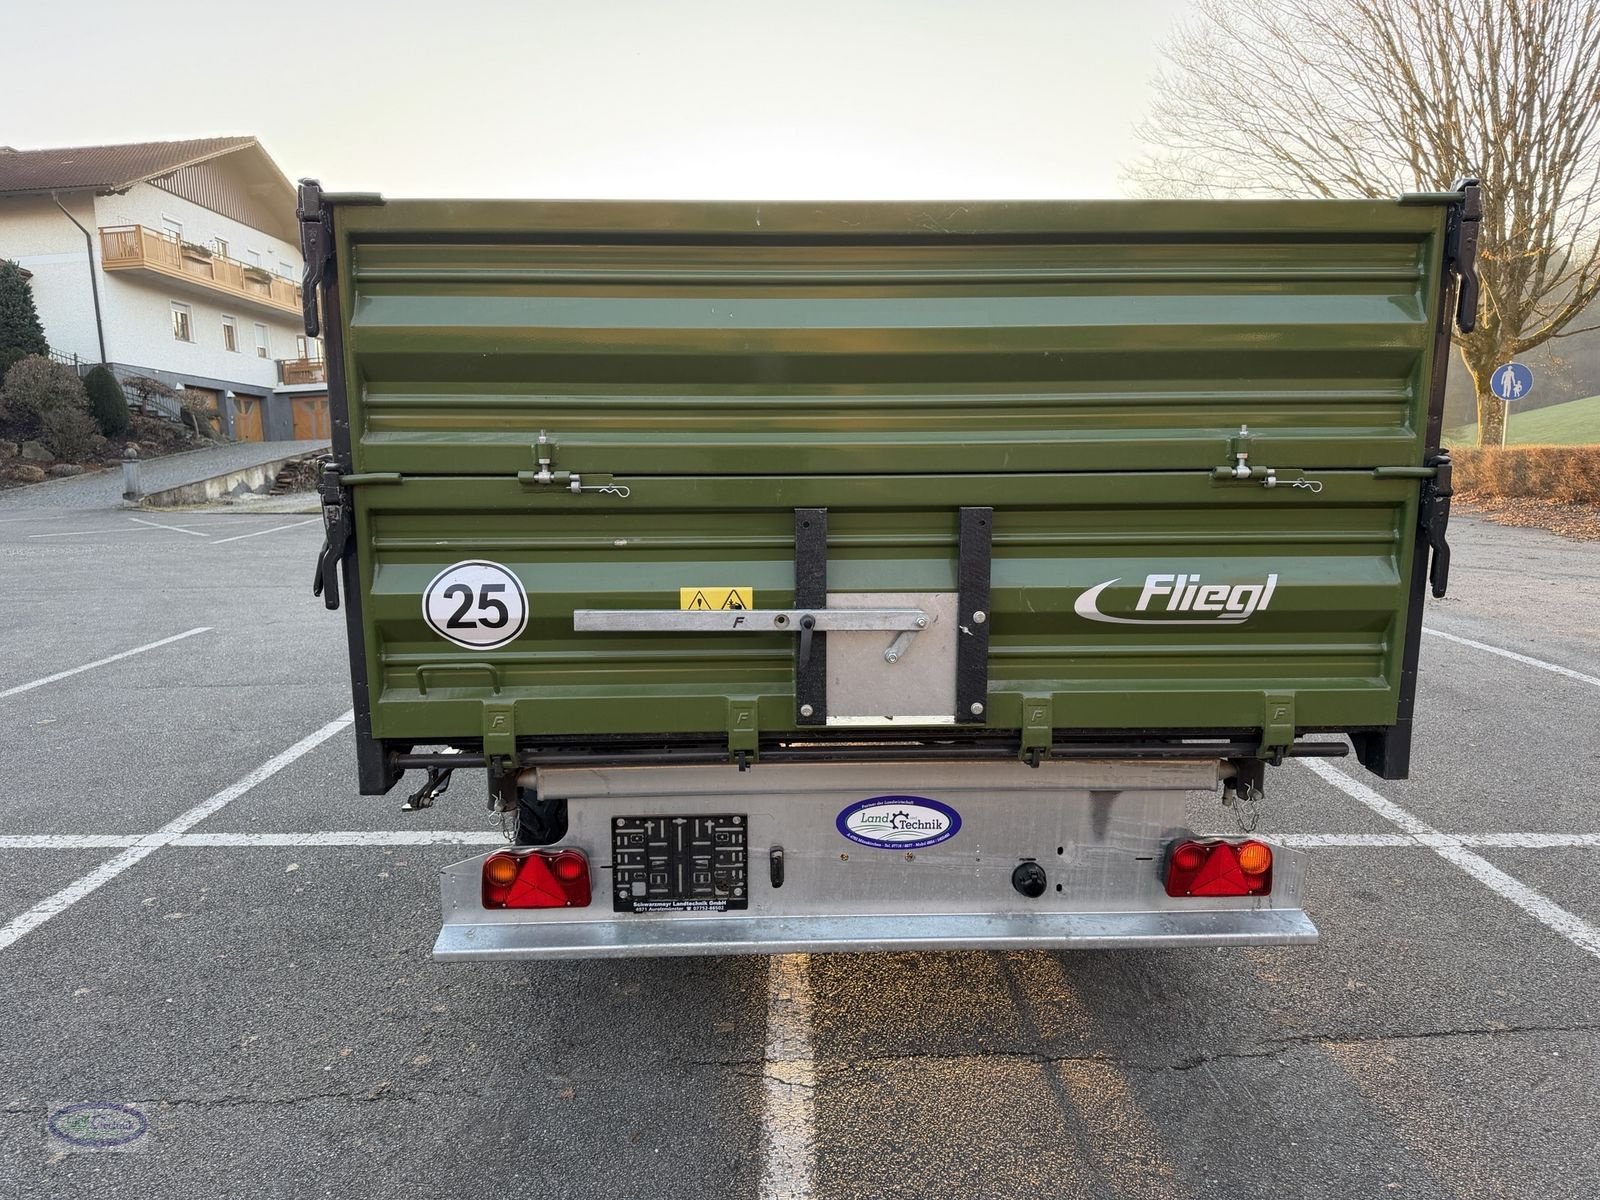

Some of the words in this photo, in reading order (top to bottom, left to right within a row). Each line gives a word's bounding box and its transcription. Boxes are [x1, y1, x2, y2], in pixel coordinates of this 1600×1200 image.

[1135, 573, 1278, 618] Fliegl
[443, 583, 509, 629] 25
[732, 616, 745, 628] F
[736, 712, 749, 725] F
[1031, 710, 1043, 722] F
[1273, 707, 1287, 720] F
[492, 716, 505, 728] F
[861, 812, 890, 823] Land
[899, 819, 943, 830] Technik
